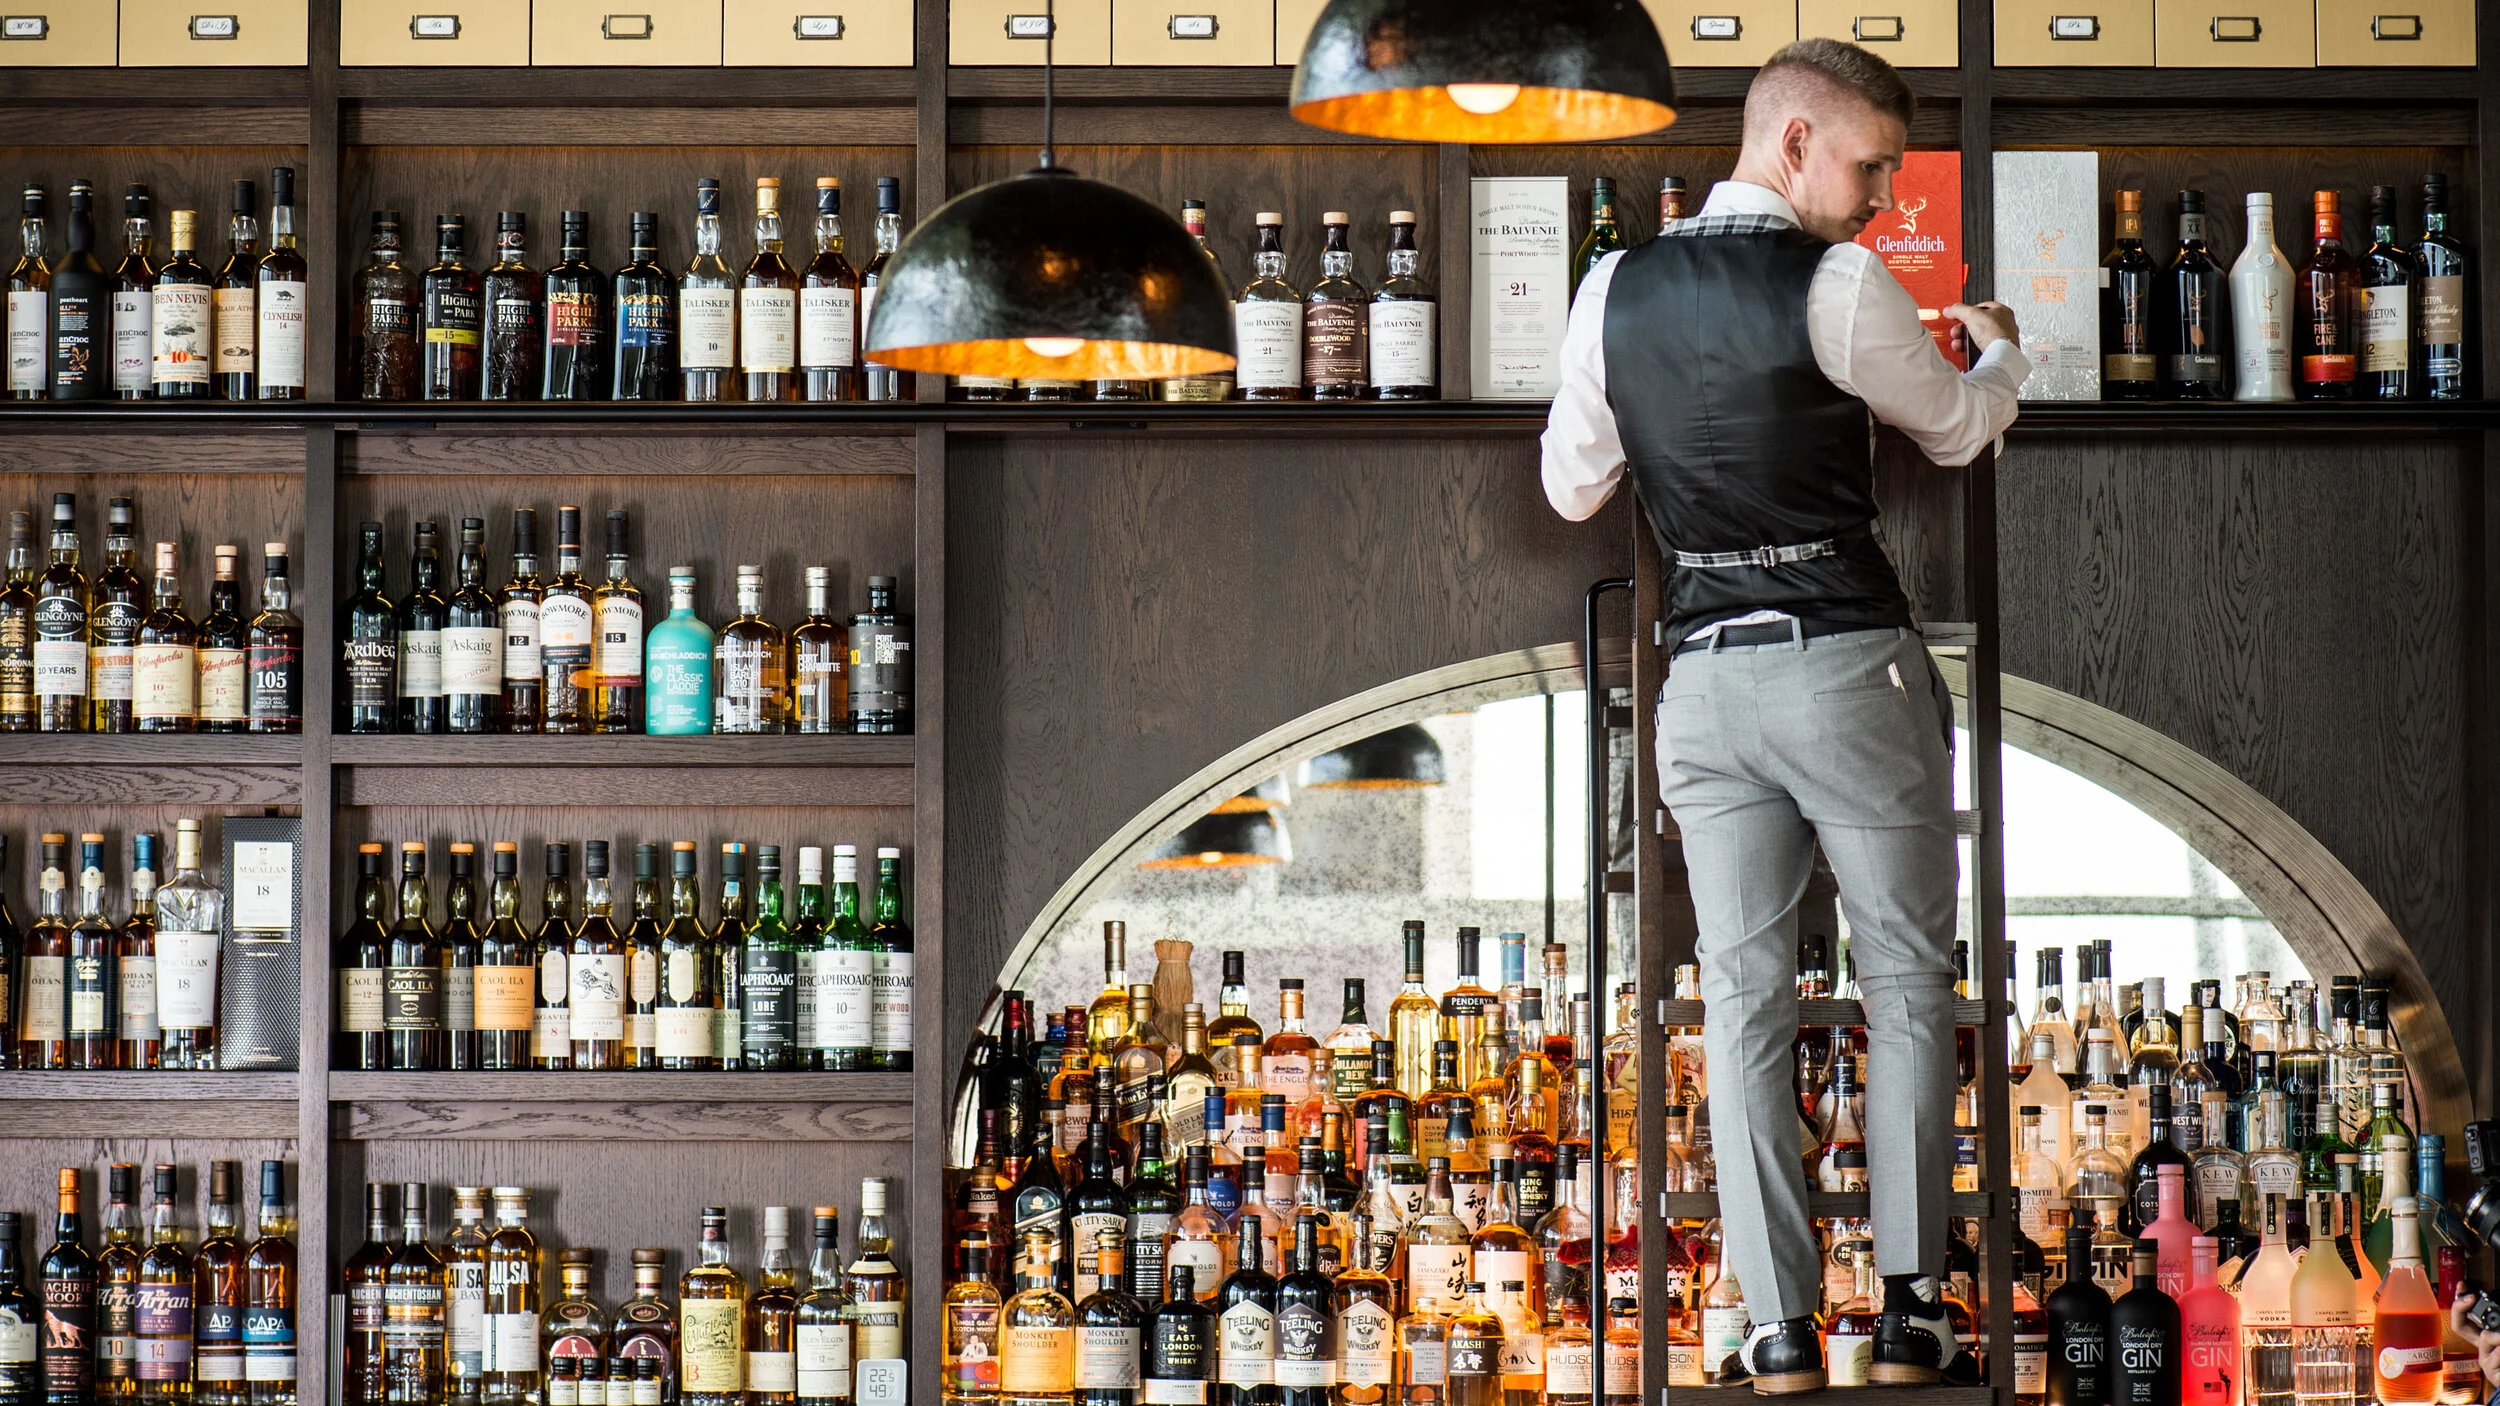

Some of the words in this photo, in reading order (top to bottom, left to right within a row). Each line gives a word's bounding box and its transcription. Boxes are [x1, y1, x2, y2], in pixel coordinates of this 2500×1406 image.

[1479, 227, 1499, 235] THE
[1501, 225, 1559, 236] BALVENIE
[1877, 236, 1945, 253] Glenfiddich
[1511, 282, 1527, 296] 21
[155, 294, 173, 304] BEN
[176, 293, 208, 304] NEVIS
[685, 299, 730, 308] TALISKER
[746, 299, 791, 308] TALISKER
[805, 299, 850, 308] TALISKER
[263, 311, 303, 321] CLYNELISH
[454, 307, 475, 319] PARK
[372, 314, 400, 324] PARK
[557, 317, 588, 327] PARK
[628, 317, 659, 328] PARK
[1256, 319, 1293, 327] BALVENIE
[1318, 318, 1355, 327] BALVENIE
[1384, 320, 1423, 328] BALVENIE
[2123, 323, 2143, 344] IPA
[2314, 323, 2331, 334] FIRE
[444, 330, 454, 340] 15
[2315, 336, 2337, 346] CANE
[708, 342, 718, 351] 10
[1262, 347, 1273, 355] 21
[2365, 343, 2375, 355] 12
[171, 350, 187, 363] 10
[35, 612, 84, 621] GLENGOYNE
[513, 637, 525, 645] 12
[610, 634, 622, 642] 15
[875, 634, 894, 643] PORT
[450, 638, 492, 656] Askaig
[875, 642, 910, 651] CHARLOTTE
[138, 651, 184, 672] Glenfarclas
[249, 652, 296, 673] Glenfarclas
[849, 649, 861, 666] 10
[49, 666, 77, 674] YEARS
[667, 664, 684, 674] THE
[256, 672, 287, 688] 105
[667, 673, 704, 683] CLASSIC
[152, 683, 165, 691] 10
[216, 687, 228, 695] 15
[667, 682, 700, 692] LADDIE
[239, 866, 288, 874] MACALLAN
[257, 885, 270, 896] 18
[162, 959, 208, 968] MACALLAN
[177, 979, 191, 990] 18
[387, 979, 416, 990] CAOL
[417, 979, 434, 990] ILA
[480, 975, 508, 986] CAOL
[508, 975, 524, 986] ILA
[363, 991, 372, 999] 12
[496, 988, 505, 996] 18
[753, 1000, 776, 1012] LORE
[1451, 996, 1494, 1006] PENDERYN
[836, 1002, 848, 1014] 10
[889, 1003, 910, 1013] WOOD
[551, 1028, 558, 1037] 8
[1345, 1070, 1367, 1081] DEW
[2172, 1116, 2190, 1126] WEST
[1519, 1178, 1542, 1187] KING
[1519, 1186, 1538, 1194] CAR
[970, 1191, 996, 1201] Naked
[1519, 1193, 1549, 1201] WHISKY
[1101, 1216, 1125, 1227] SARK
[489, 1260, 529, 1285] AILSA
[448, 1268, 484, 1290] AILSA
[385, 1288, 442, 1301] AUCHENTOSHAN
[461, 1290, 482, 1300] BAY
[489, 1285, 509, 1295] BAY
[135, 1290, 189, 1309] Arran
[1226, 1316, 1270, 1332] TEELING
[1280, 1319, 1323, 1334] TEELING
[1343, 1316, 1387, 1331] TEELING
[1015, 1332, 1055, 1341] MONKEY
[1087, 1329, 1126, 1338] MONKEY
[1168, 1334, 1196, 1342] EAST
[801, 1336, 822, 1344] GLEN
[1012, 1340, 1058, 1349] SHOULDER
[1084, 1337, 1130, 1346] SHOULDER
[1451, 1340, 1486, 1349] AKASHI
[108, 1340, 124, 1356] 10
[1161, 1342, 1202, 1351] LONDON
[1230, 1341, 1264, 1351] WHISKEY
[1283, 1343, 1317, 1354] WHISKEY
[1347, 1340, 1381, 1351] WHISKEY
[149, 1343, 165, 1359] 14
[2065, 1343, 2104, 1363] GIN
[1167, 1357, 1197, 1365] WHISKY
[1668, 1353, 1695, 1364] SON
[2122, 1349, 2162, 1368] GIN
[2190, 1348, 2232, 1368] GIN
[685, 1363, 700, 1383] 13
